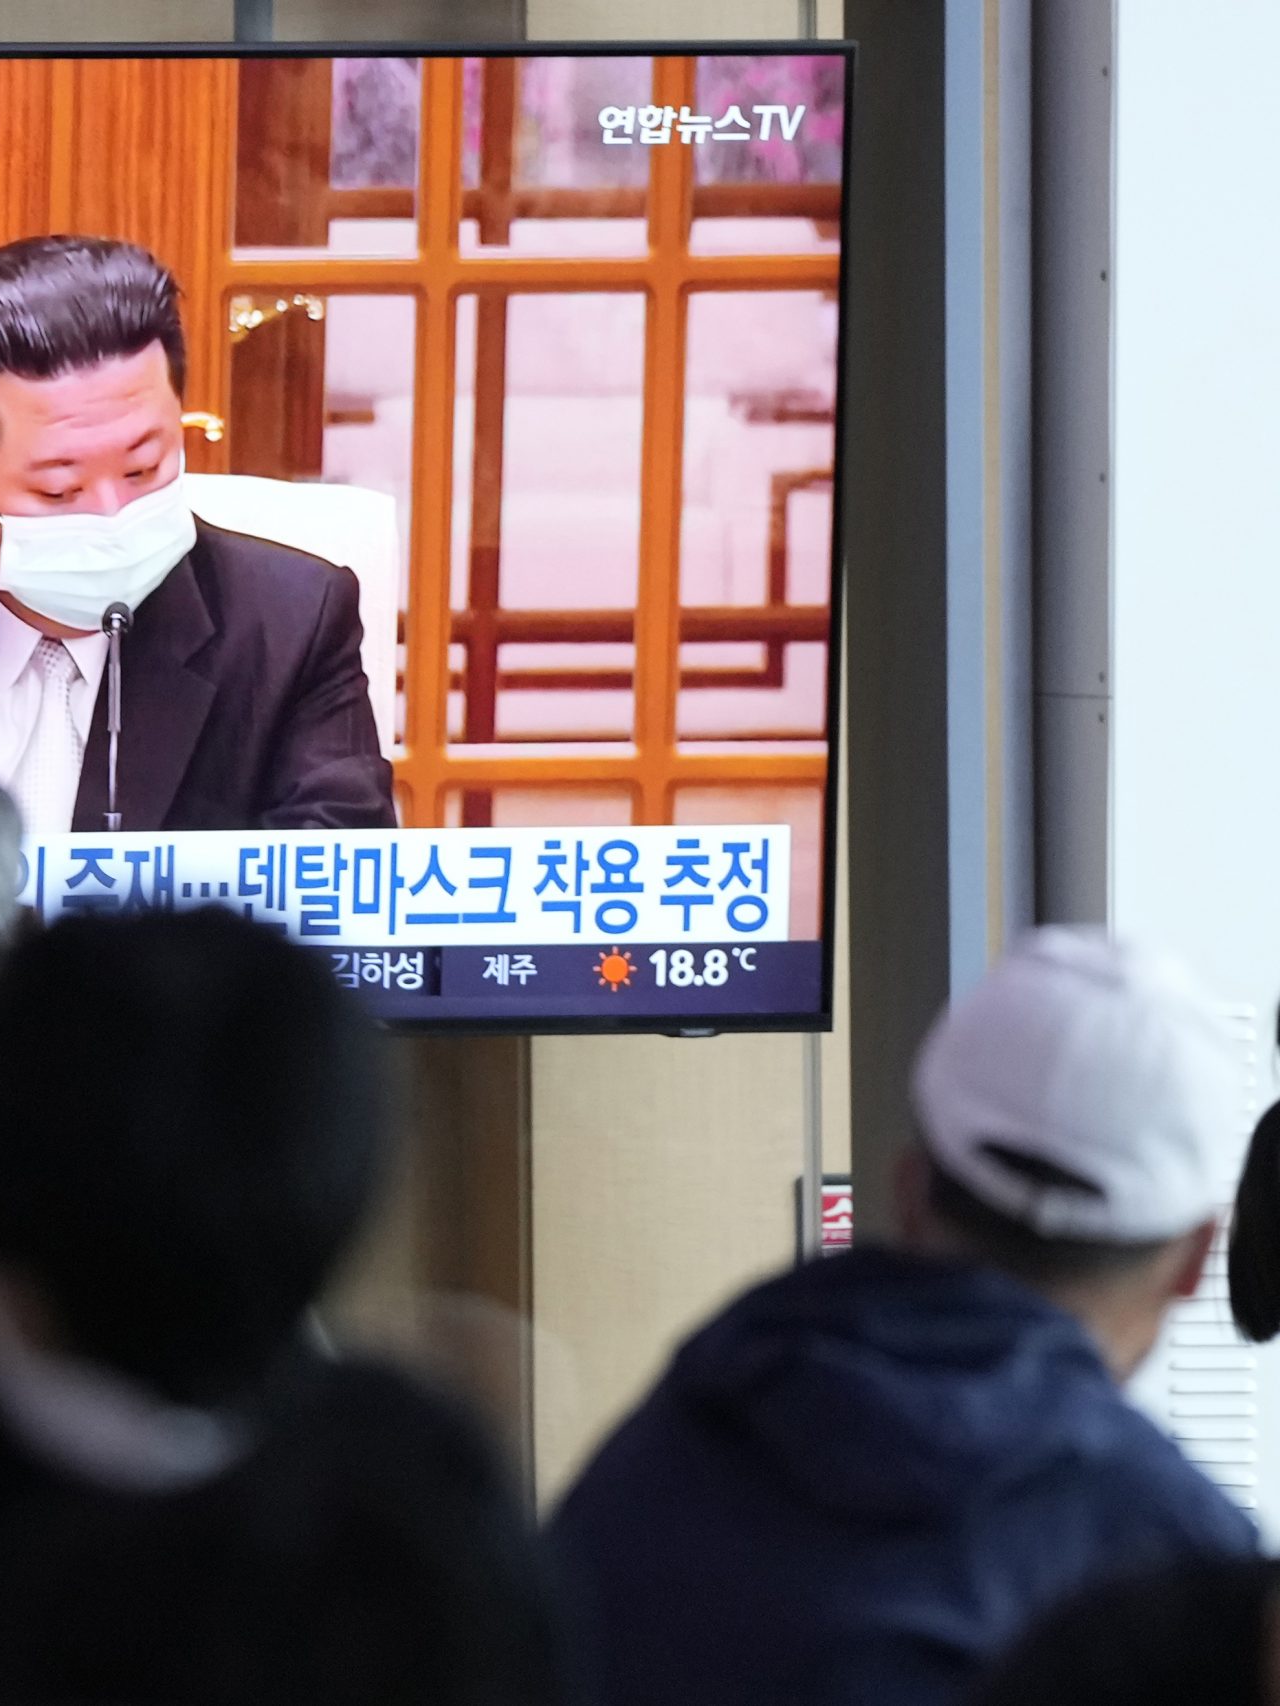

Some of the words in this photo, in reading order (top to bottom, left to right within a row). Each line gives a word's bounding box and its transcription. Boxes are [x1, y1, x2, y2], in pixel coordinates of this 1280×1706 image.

[597, 104, 806, 145] 연합뉴스TV
[533, 838, 646, 935] 착용
[659, 836, 770, 934] 추정
[331, 950, 425, 990] 김하성
[482, 953, 538, 988] 제주
